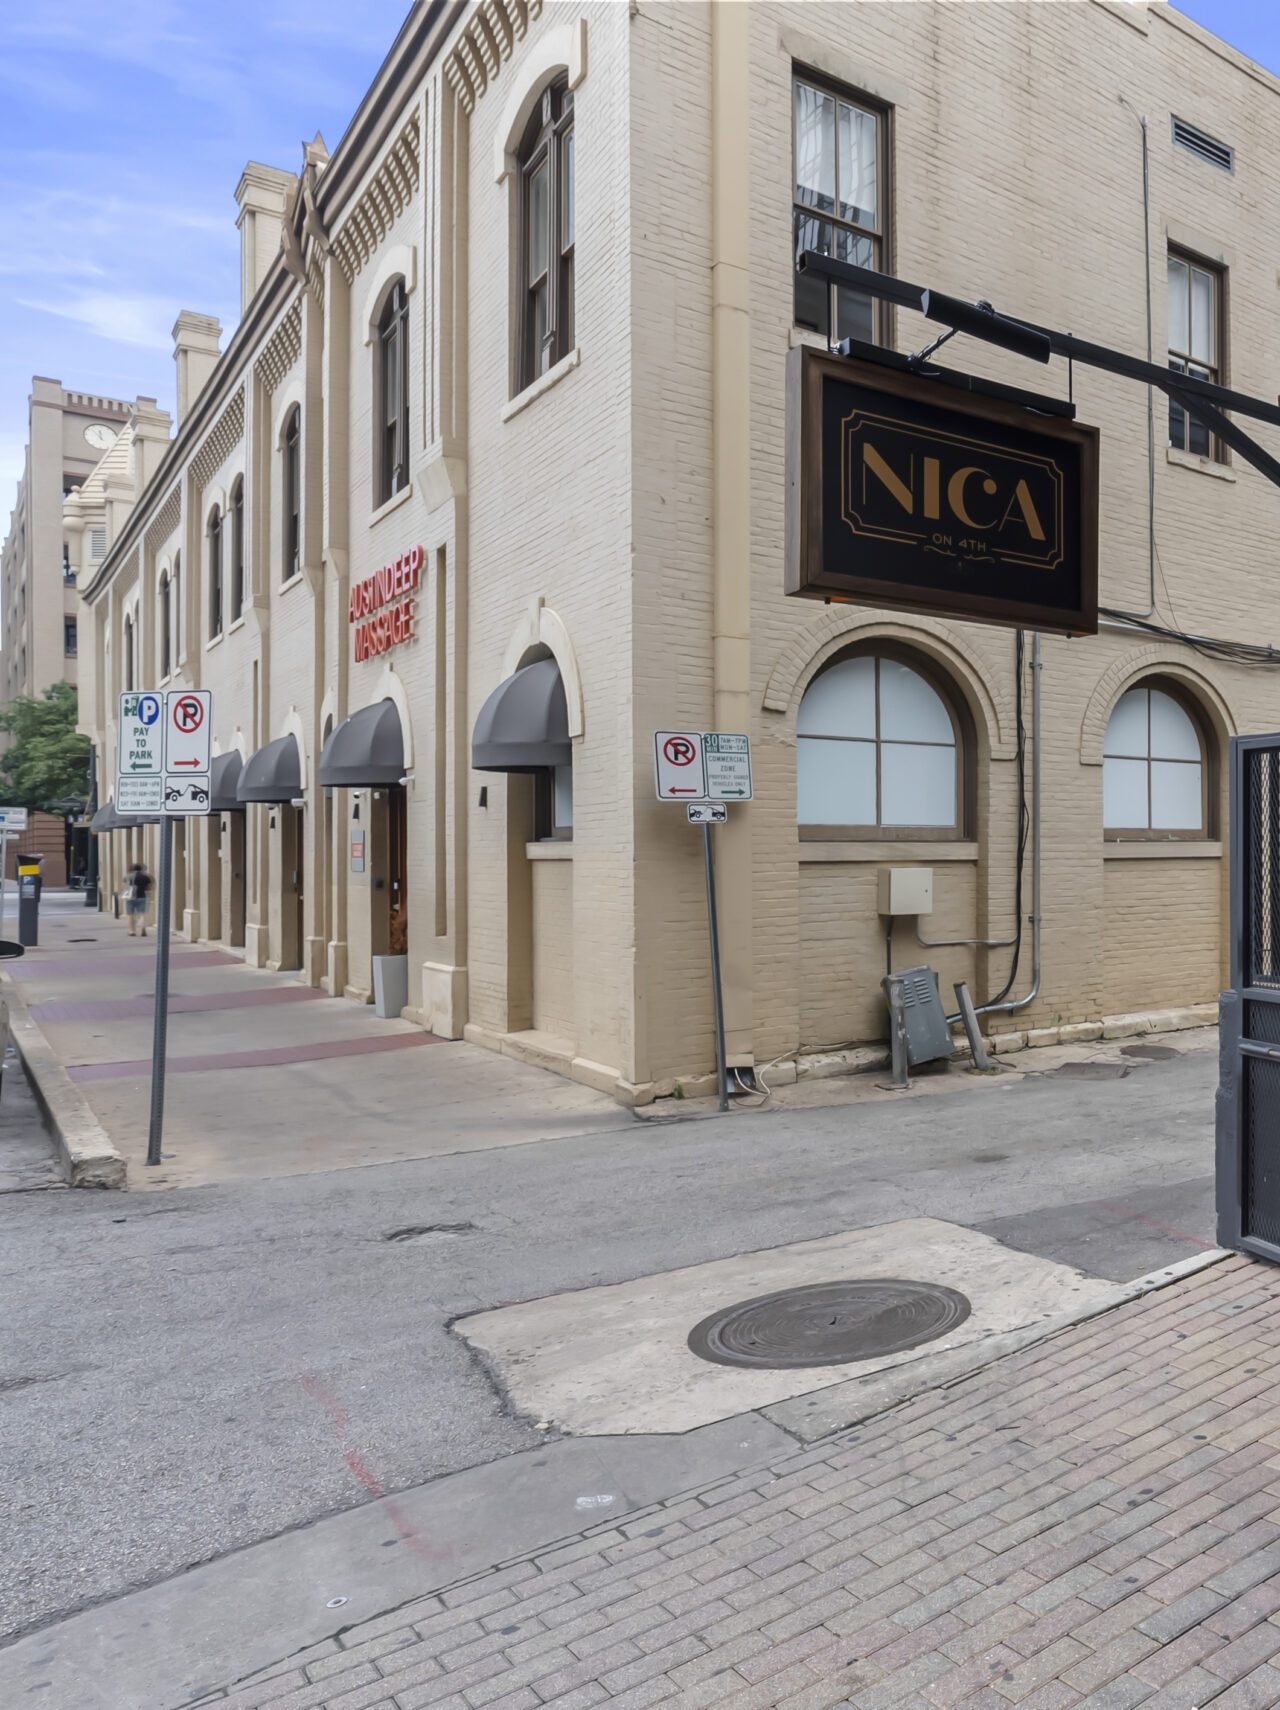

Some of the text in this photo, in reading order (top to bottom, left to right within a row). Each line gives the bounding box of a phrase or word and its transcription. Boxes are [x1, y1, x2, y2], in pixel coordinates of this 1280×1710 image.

[863, 442, 1046, 541] NICA
[932, 532, 987, 553] ON 4TH
[349, 544, 424, 623] AUSTIN DEEP
[355, 597, 415, 663] MASSAGE
[133, 727, 150, 737] PAY
[135, 738, 147, 748] TO
[705, 734, 718, 746] 30
[129, 750, 153, 760] PARK
[708, 755, 747, 763] COMMERCIAL
[720, 765, 737, 773] ZONE
